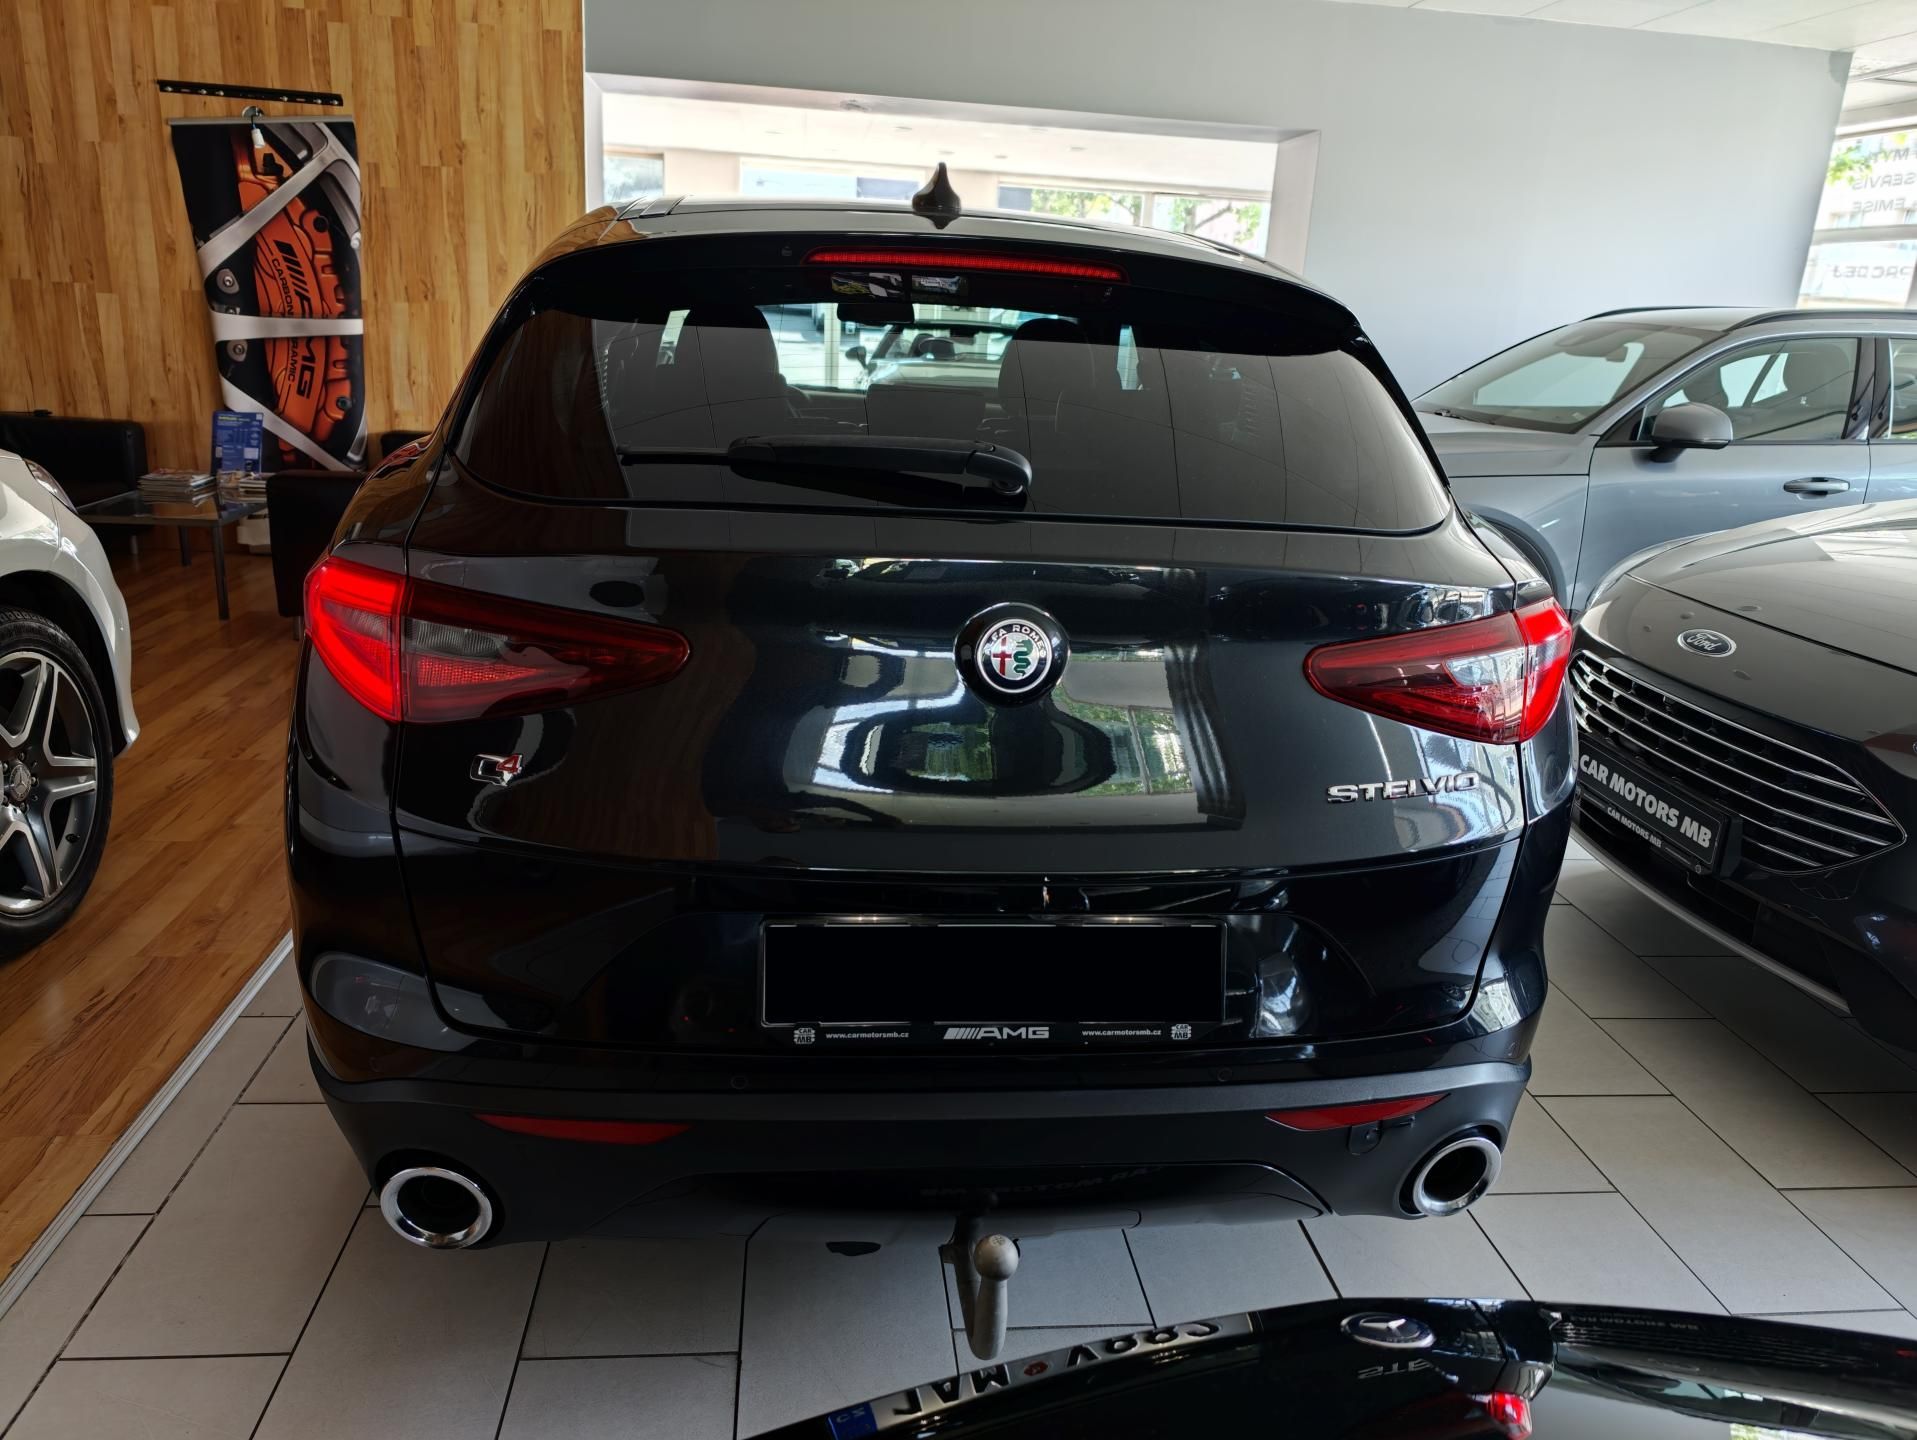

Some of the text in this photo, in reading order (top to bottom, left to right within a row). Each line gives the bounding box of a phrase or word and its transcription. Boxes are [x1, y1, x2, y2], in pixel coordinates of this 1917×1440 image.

[1012, 623, 1048, 658] ROMEO
[1686, 632, 1722, 651] Ford
[1327, 770, 1481, 804] STELVIO
[1579, 754, 1712, 848] CAR MOTORS MB
[1607, 806, 1621, 822] CAR
[1620, 815, 1650, 840] MOTORS
[825, 1031, 910, 1040] www.carmotorsmb.cz
[1081, 1028, 1162, 1037] www.carmotorsmb.cz
